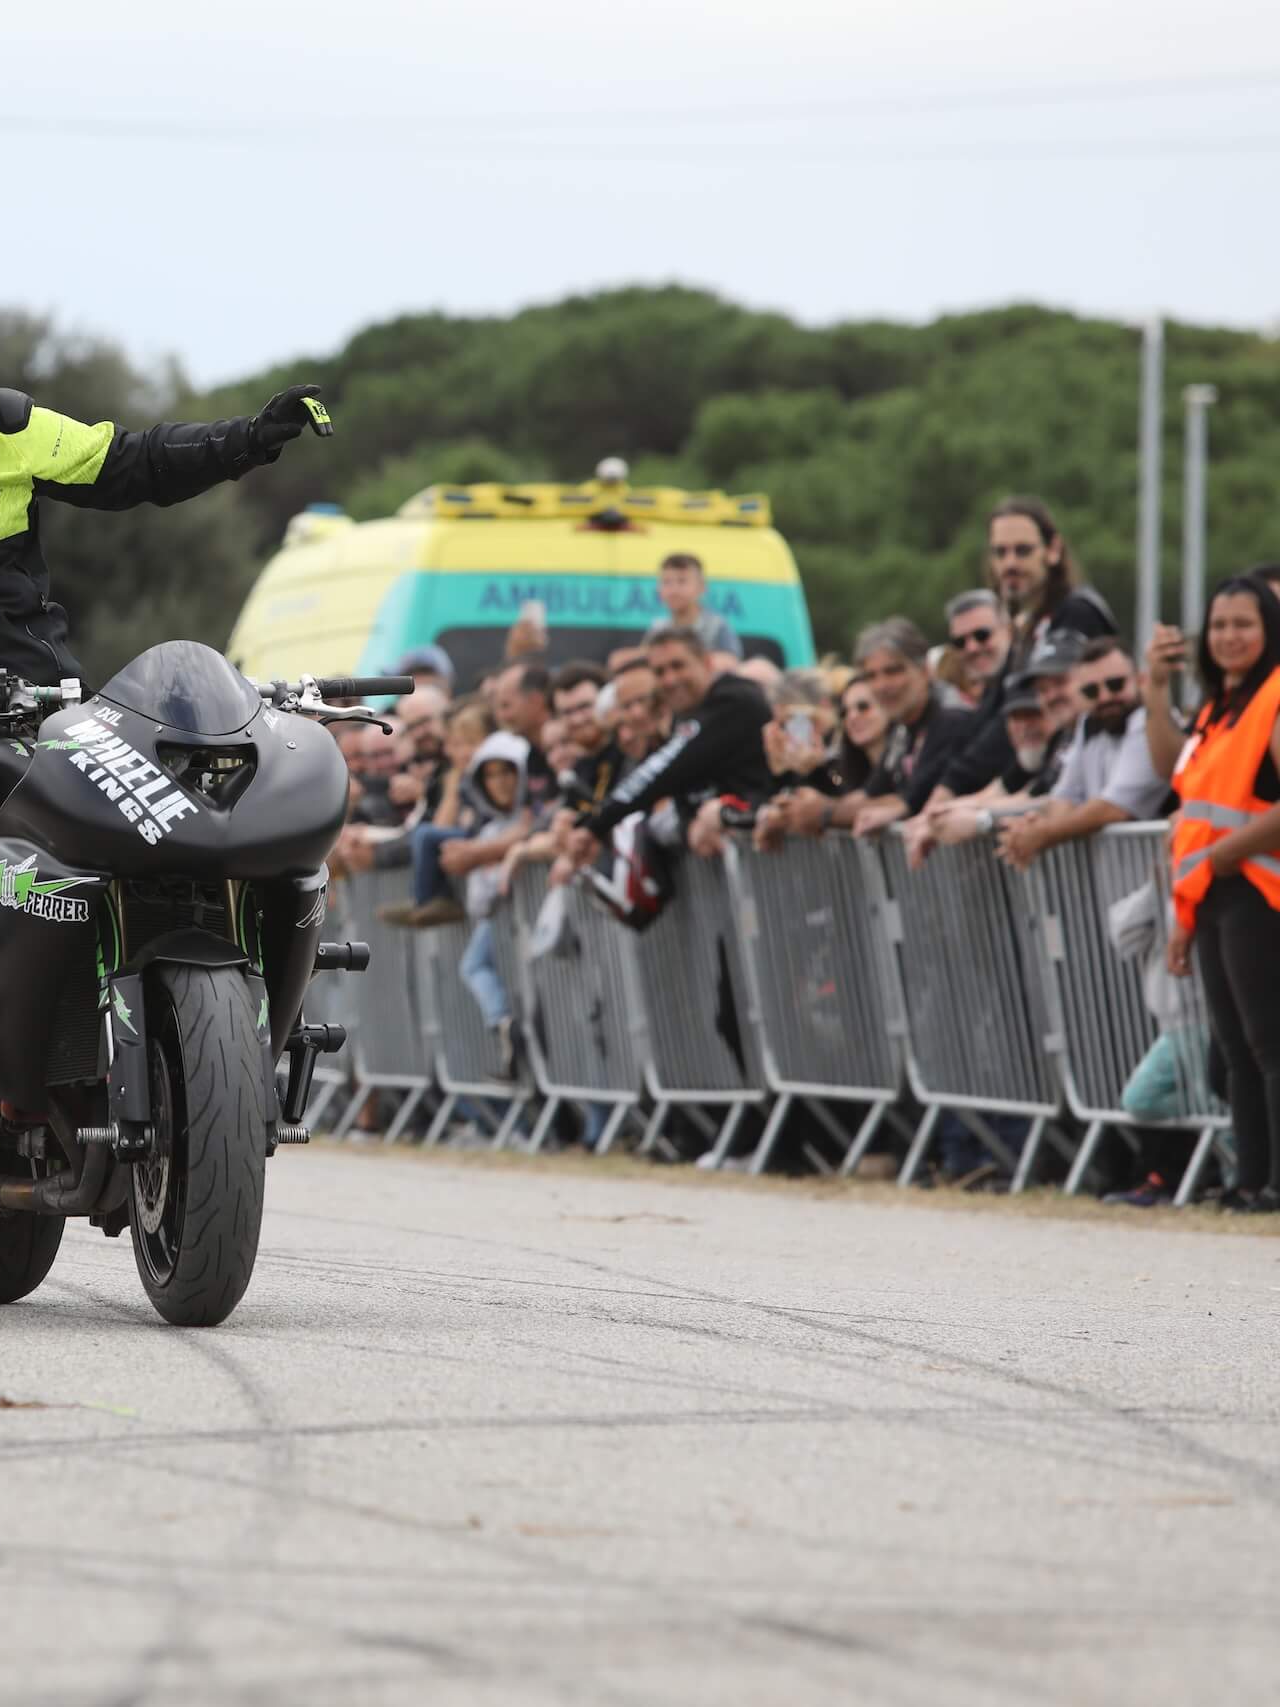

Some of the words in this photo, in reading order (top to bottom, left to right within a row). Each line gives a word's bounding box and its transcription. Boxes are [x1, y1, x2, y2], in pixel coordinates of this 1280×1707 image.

[63, 718, 199, 833] WHEELIE
[68, 750, 163, 846] KINGS
[24, 891, 90, 922] FERRER
